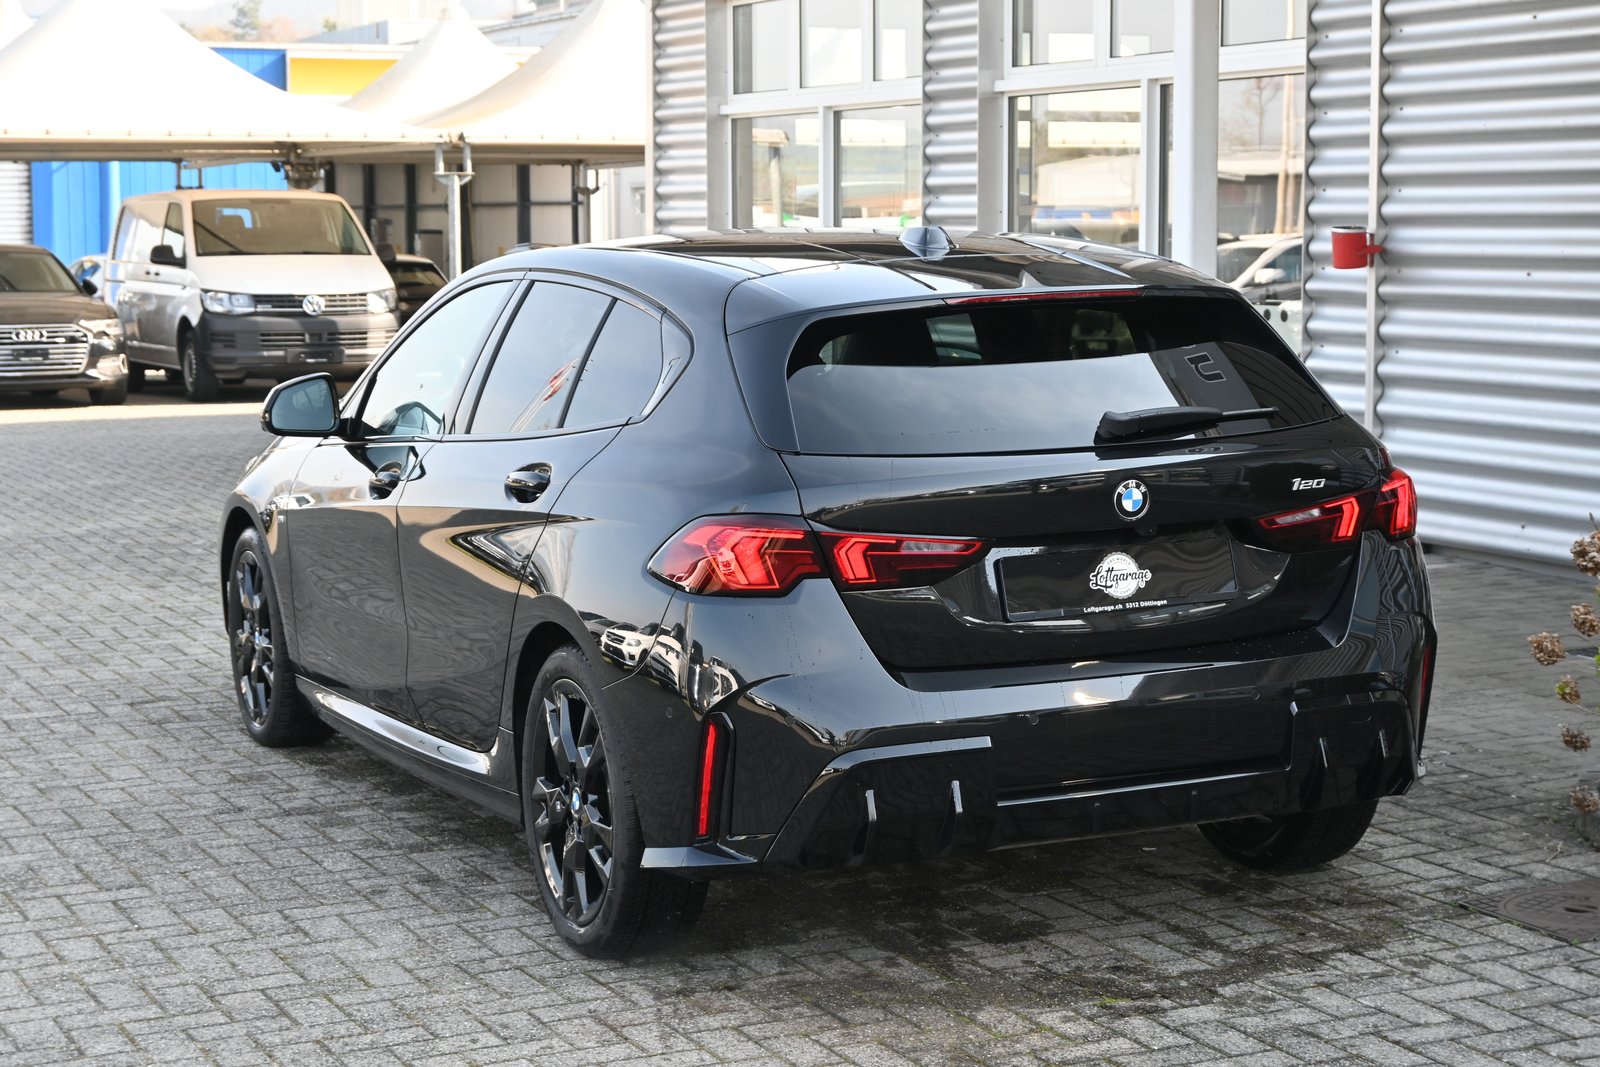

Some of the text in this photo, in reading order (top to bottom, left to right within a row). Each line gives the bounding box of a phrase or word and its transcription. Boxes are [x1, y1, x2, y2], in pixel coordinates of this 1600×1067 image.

[1292, 477, 1326, 491] 120
[1090, 564, 1151, 592] Loftgarage
[1083, 603, 1123, 613] Loftgarage.ch
[1125, 601, 1140, 609] 5312
